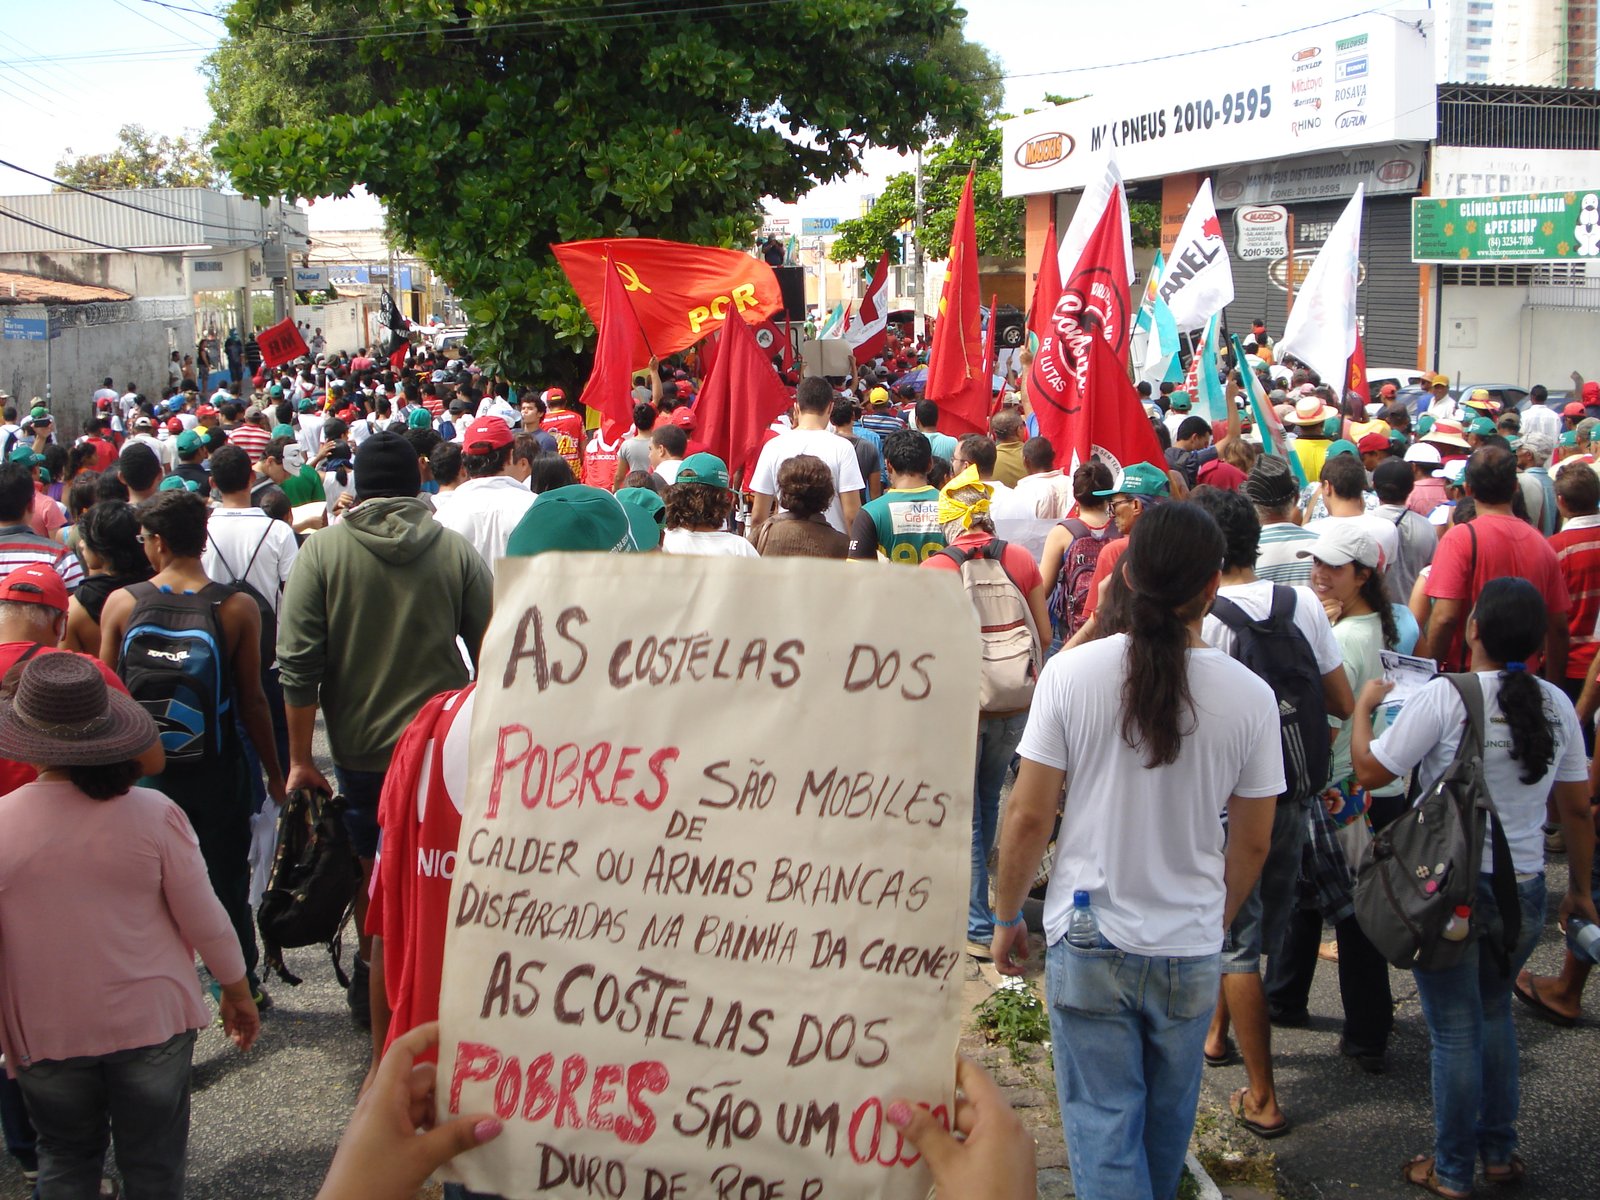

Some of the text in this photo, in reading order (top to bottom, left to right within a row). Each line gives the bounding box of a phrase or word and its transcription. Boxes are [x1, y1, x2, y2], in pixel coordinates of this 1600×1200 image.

[1296, 60, 1322, 72] DUNLOP
[1335, 84, 1367, 101] ROSAVA
[1090, 84, 1272, 152] MX PNEUS 2010-9595
[1291, 117, 1321, 137] RHINO
[1024, 134, 1063, 166] MAXXIS
[1263, 169, 1288, 185] PNEUS
[1289, 162, 1351, 181] DISTRIBUIDORA
[1353, 159, 1375, 175] LTDA
[1297, 183, 1340, 196] 2010-9595
[1459, 196, 1566, 217] CLÍNICA VETERINÁRIA
[1510, 218, 1538, 234] SHOP
[1159, 240, 1220, 307] ANEL
[688, 283, 759, 334] PCR
[1040, 337, 1067, 392] DE LUTAS
[1100, 449, 1112, 460] SEM
[912, 504, 939, 513] Nata
[502, 604, 936, 701] AS COSTELAS DOS
[483, 722, 952, 829] POBRES SÃO MOBILES
[665, 810, 707, 841] DE
[467, 827, 933, 912] CALDER OU ARMAS BRANCAS
[637, 914, 681, 952] NA
[694, 914, 798, 965] BAINHA
[810, 930, 846, 972] DA
[859, 938, 960, 993] CARNE?
[480, 952, 892, 1069] AS COSTELAS DOS
[449, 1041, 670, 1145] POBRES
[673, 1079, 763, 1149] SÃO
[776, 1101, 839, 1158] UM
[536, 1142, 626, 1197] DURO
[643, 1168, 688, 1200] DE
